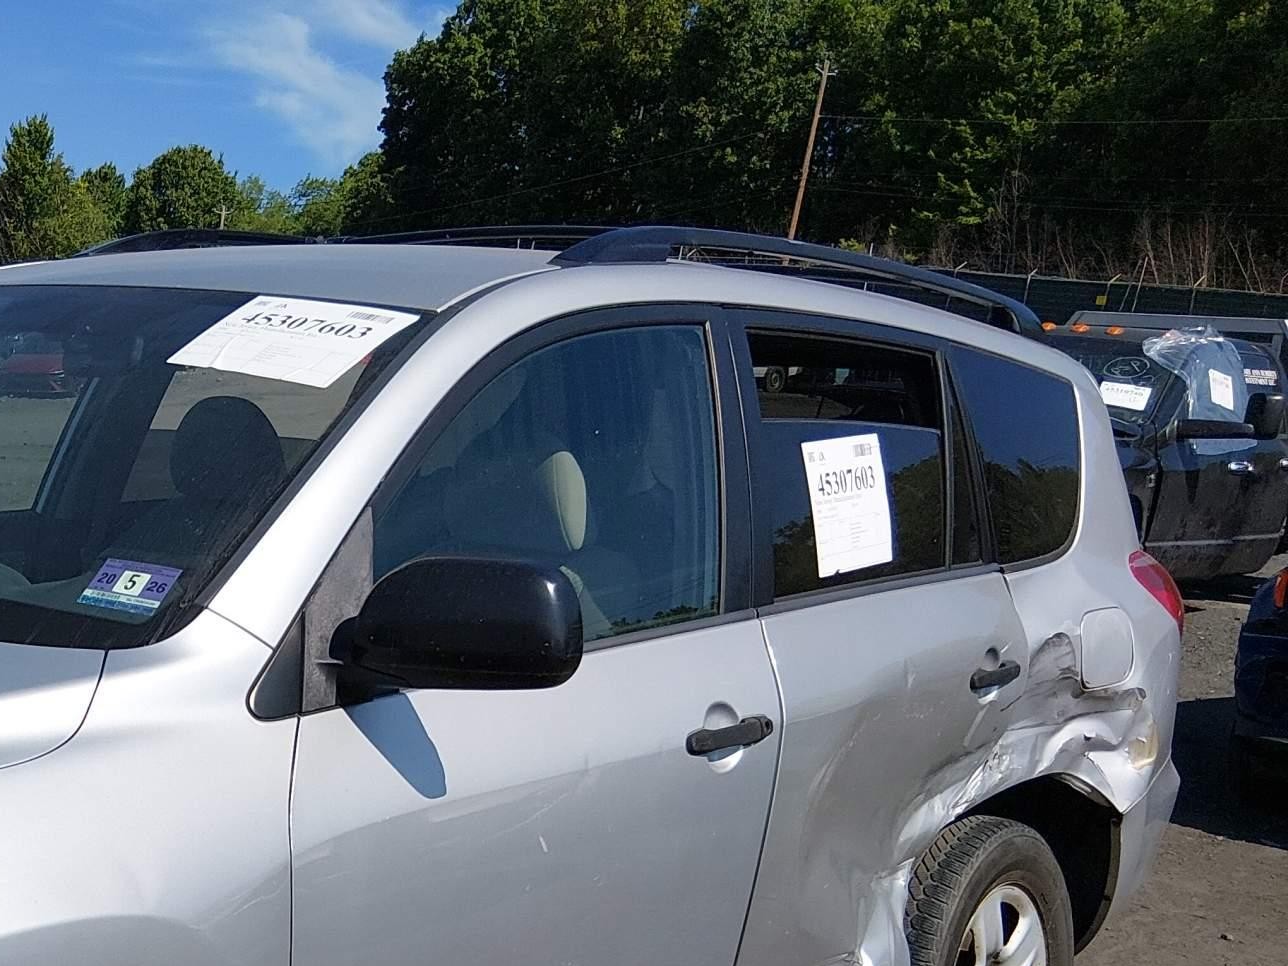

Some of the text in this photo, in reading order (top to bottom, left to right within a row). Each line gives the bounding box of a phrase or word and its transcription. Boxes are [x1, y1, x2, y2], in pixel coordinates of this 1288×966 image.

[242, 311, 374, 339] 45307603
[817, 465, 876, 496] 45307603
[97, 572, 168, 594] 20 5 26
